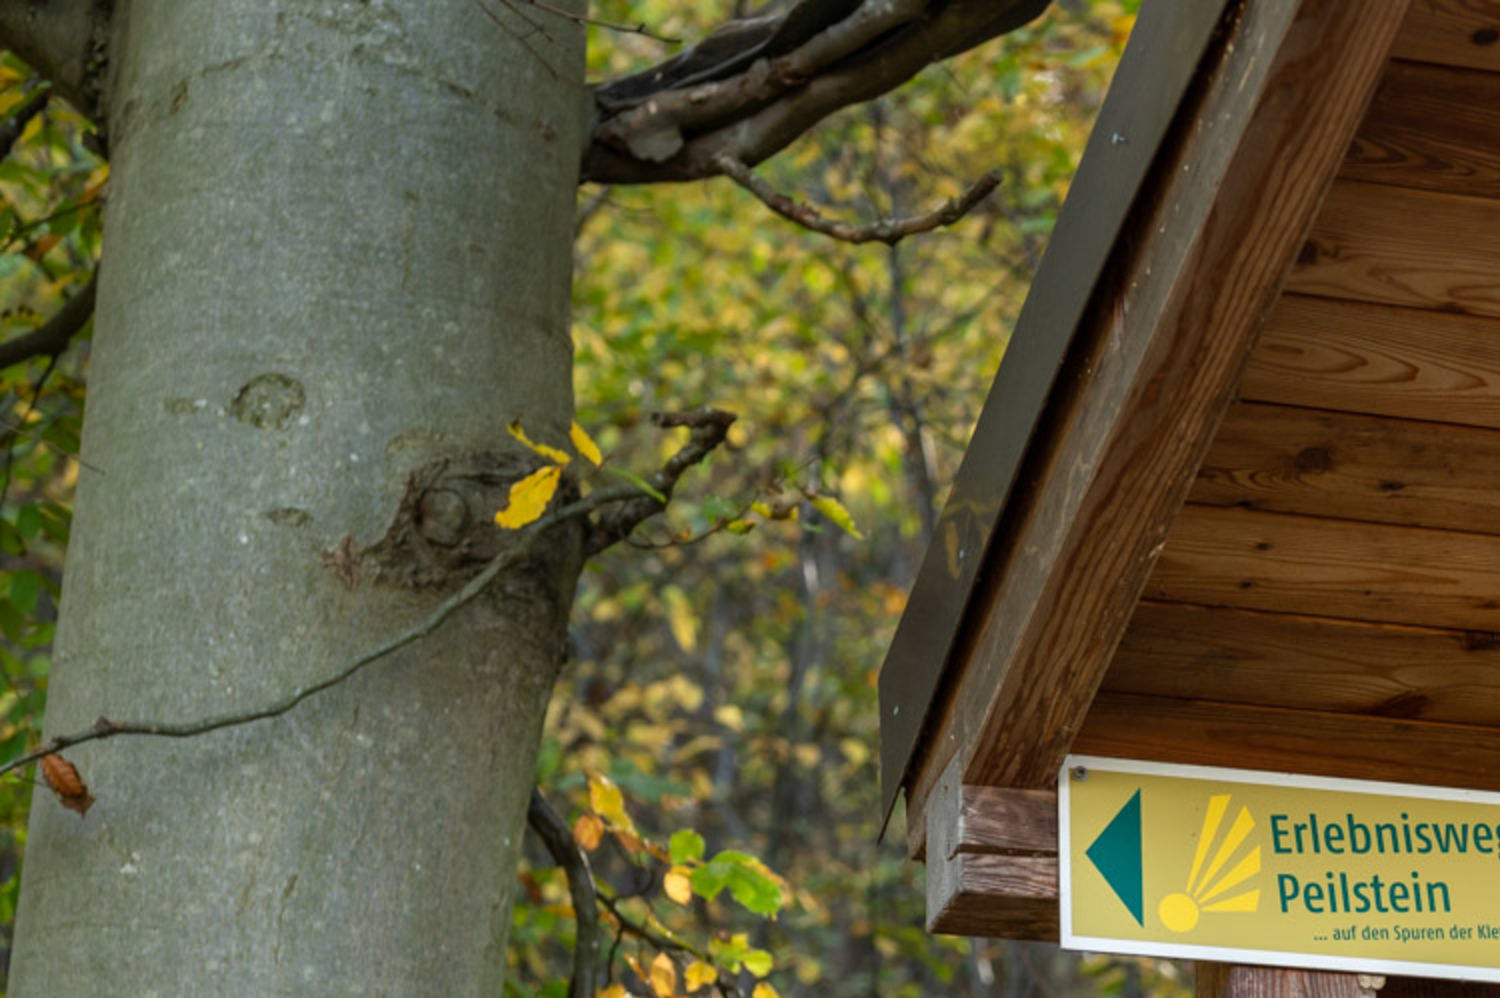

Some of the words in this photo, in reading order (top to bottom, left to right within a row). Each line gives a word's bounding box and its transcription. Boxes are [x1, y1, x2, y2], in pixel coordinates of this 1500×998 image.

[1277, 871, 1452, 913] Peilstein
[1333, 926, 1356, 941] auf
[1361, 926, 1389, 941] den
[1393, 925, 1443, 943] Spuren
[1449, 924, 1472, 940] der
